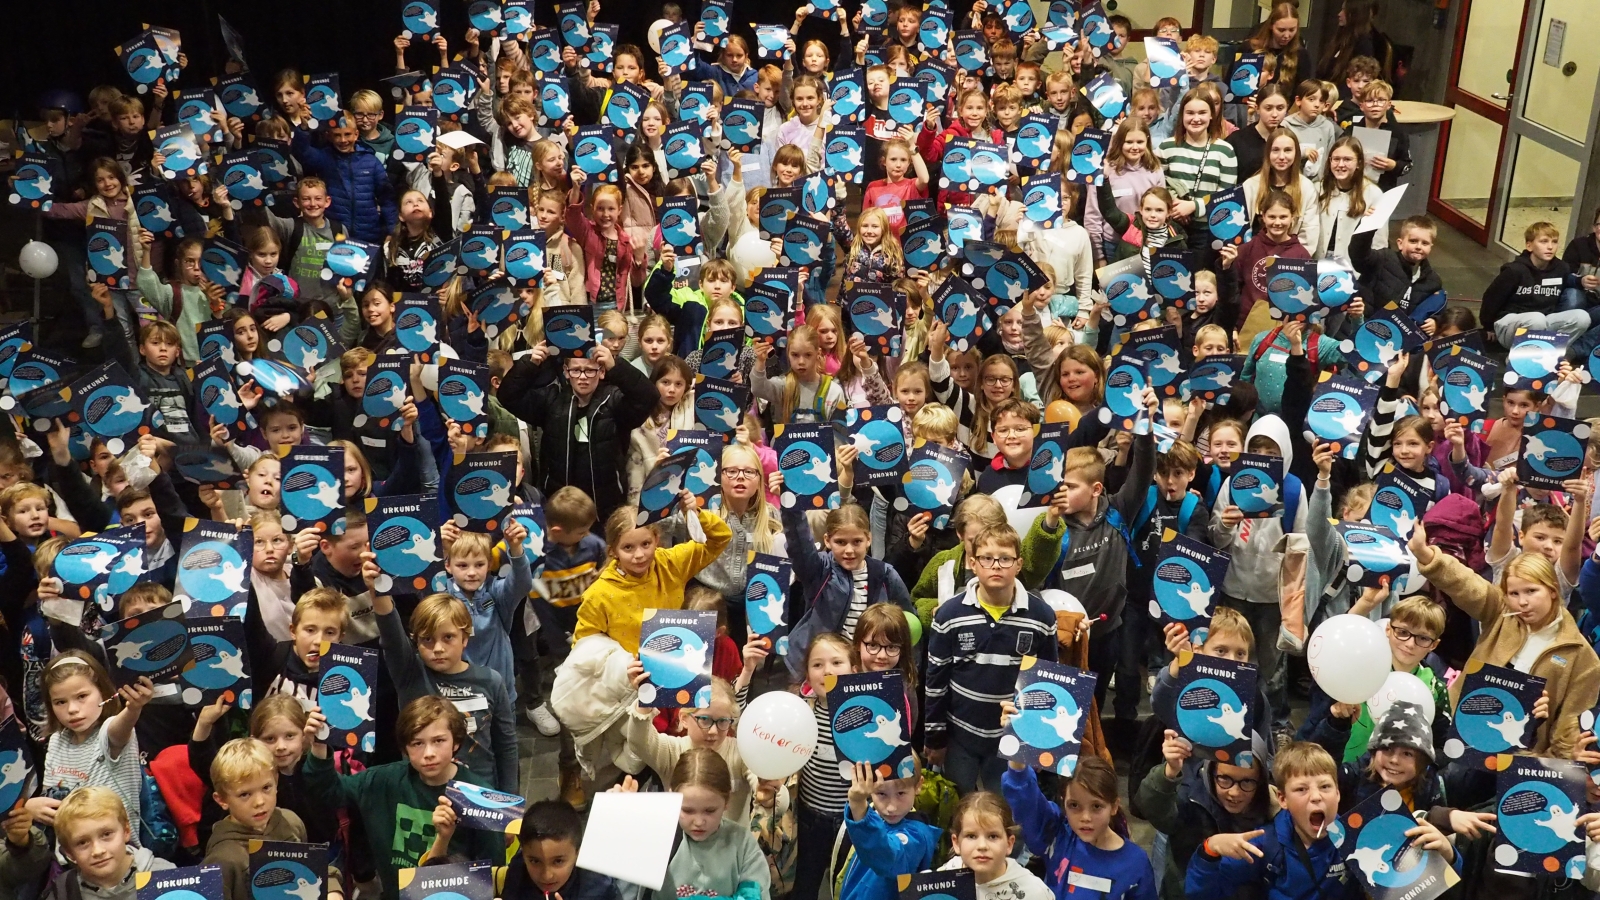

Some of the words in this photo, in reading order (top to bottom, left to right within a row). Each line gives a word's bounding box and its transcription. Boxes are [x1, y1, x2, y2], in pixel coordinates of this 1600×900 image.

[797, 220, 818, 229] URKUNDE
[910, 224, 930, 232] URKUNDE
[1017, 258, 1036, 276] URKUNDE
[754, 288, 777, 297] URKUNDE
[938, 286, 952, 303] URKUNDE
[1516, 285, 1530, 295] Los
[1534, 285, 1561, 296] Angele
[1391, 314, 1411, 336] URKUNDE
[319, 323, 336, 346] URKUNDE
[1135, 334, 1164, 342] URKUNDE
[1437, 338, 1466, 349] URKUNDE
[31, 353, 61, 366] URKUNDE
[1461, 356, 1485, 370] URKUNDE
[198, 365, 216, 378] URKUNDE
[449, 366, 476, 375] URKUNDE
[78, 374, 109, 395] URKUNDE
[706, 383, 733, 393] URKUNDE
[1331, 382, 1362, 395] URKUNDE
[925, 450, 954, 464] URKUNDE
[1242, 460, 1270, 468] URKUNDE
[869, 471, 898, 479] URKUNDE
[1393, 476, 1418, 497] URKUNDE
[382, 505, 420, 514] URKUNDE
[201, 530, 238, 540] URKUNDE
[1176, 544, 1210, 564] URKUNDE
[332, 654, 362, 665] URKUNDE
[1037, 670, 1076, 685] URKUNDE
[1196, 666, 1236, 679] URKUNDE
[844, 682, 883, 693] URKUNDE
[1485, 675, 1525, 690] URKUNDE
[1518, 768, 1563, 778] URKUNDE
[462, 808, 503, 820] URKUNDE
[267, 851, 308, 859] URKUNDE
[157, 877, 201, 889] URKUNDE
[421, 876, 469, 889] URKUNDE
[917, 881, 956, 892] URKUNDE
[1400, 875, 1437, 900] URKUND
